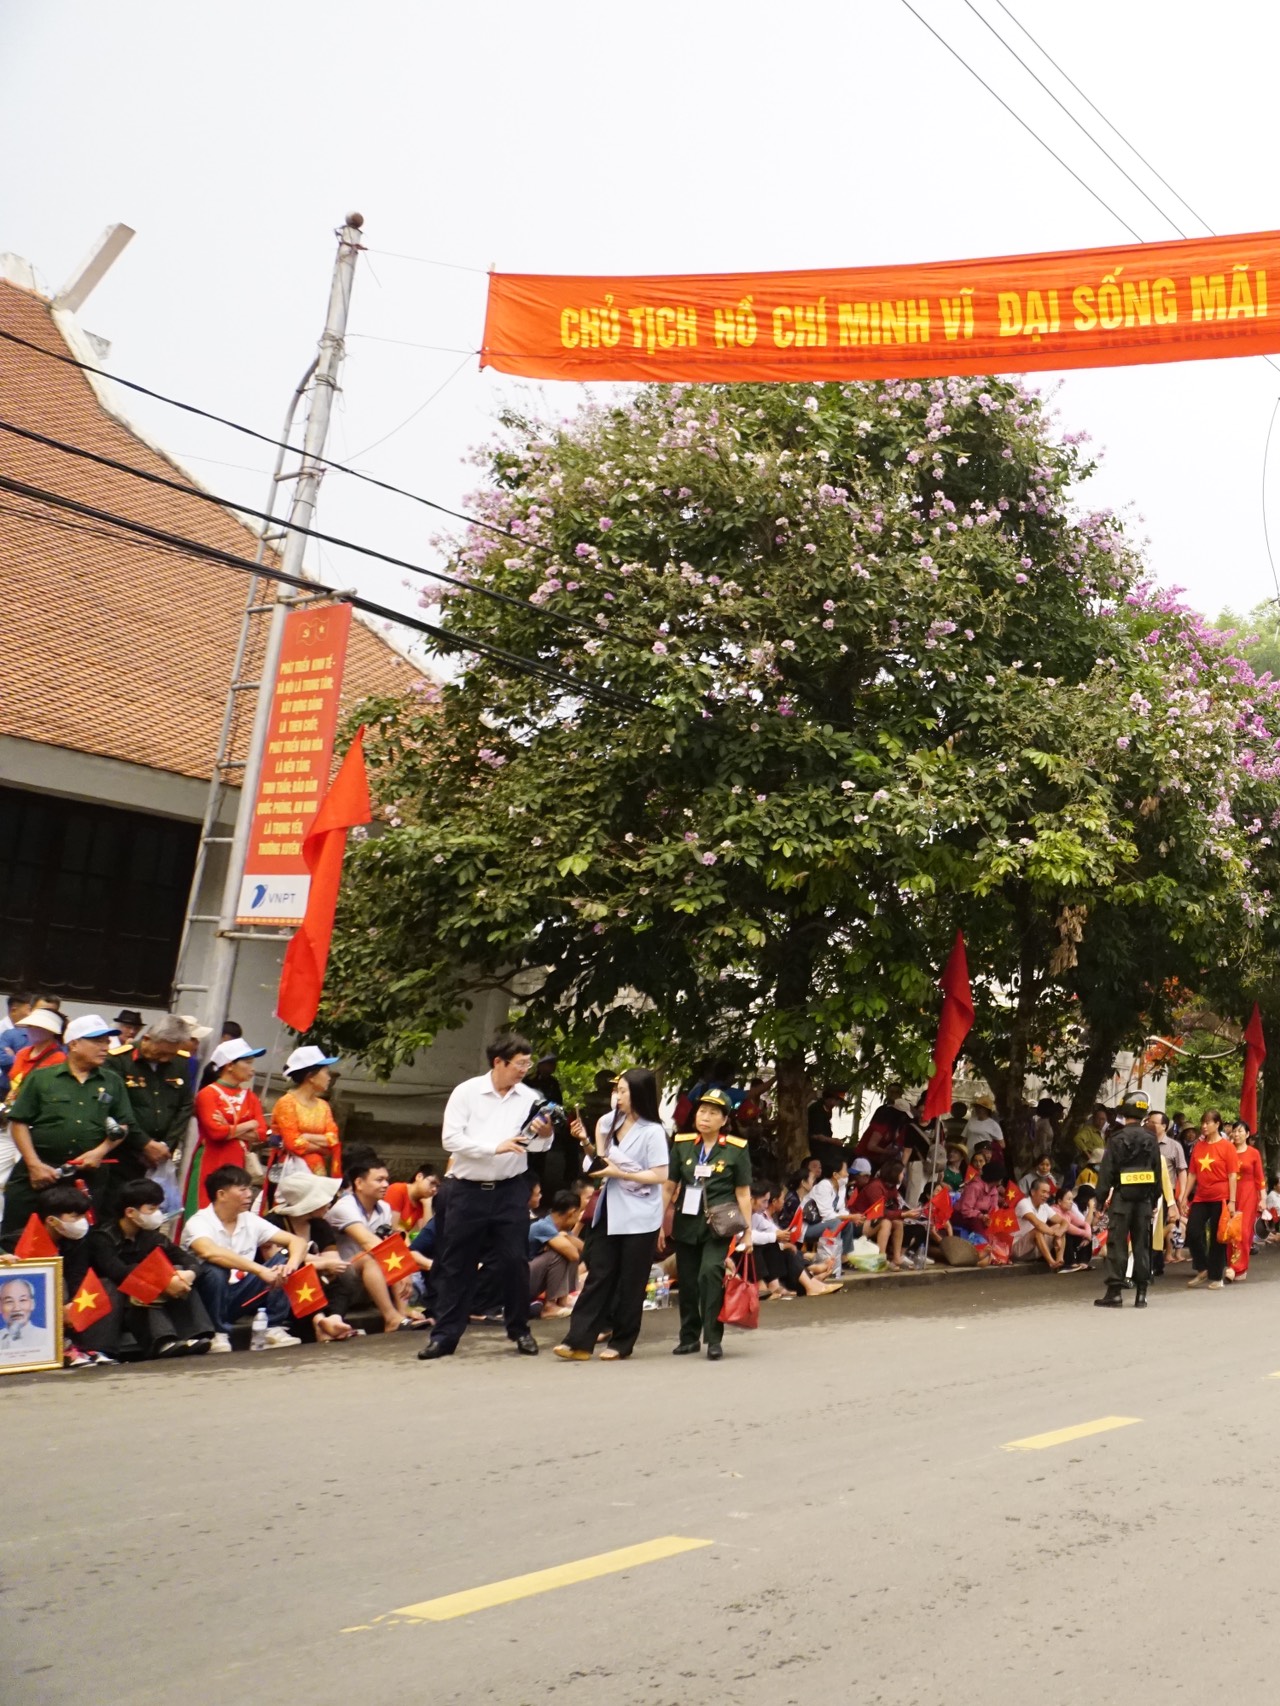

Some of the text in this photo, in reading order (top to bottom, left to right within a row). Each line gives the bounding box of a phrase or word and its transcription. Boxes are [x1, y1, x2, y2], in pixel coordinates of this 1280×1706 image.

[560, 294, 620, 348] CHỦ
[628, 306, 697, 355] TỊCH
[714, 295, 757, 348] HỒ
[772, 297, 827, 348] CHÍ
[838, 299, 930, 346] MINH
[941, 287, 974, 340] VĨ
[998, 289, 1060, 342] ĐẠI
[1074, 267, 1177, 338] SỐNG
[1191, 263, 1267, 321] MÃI
[269, 893, 296, 904] VNPT
